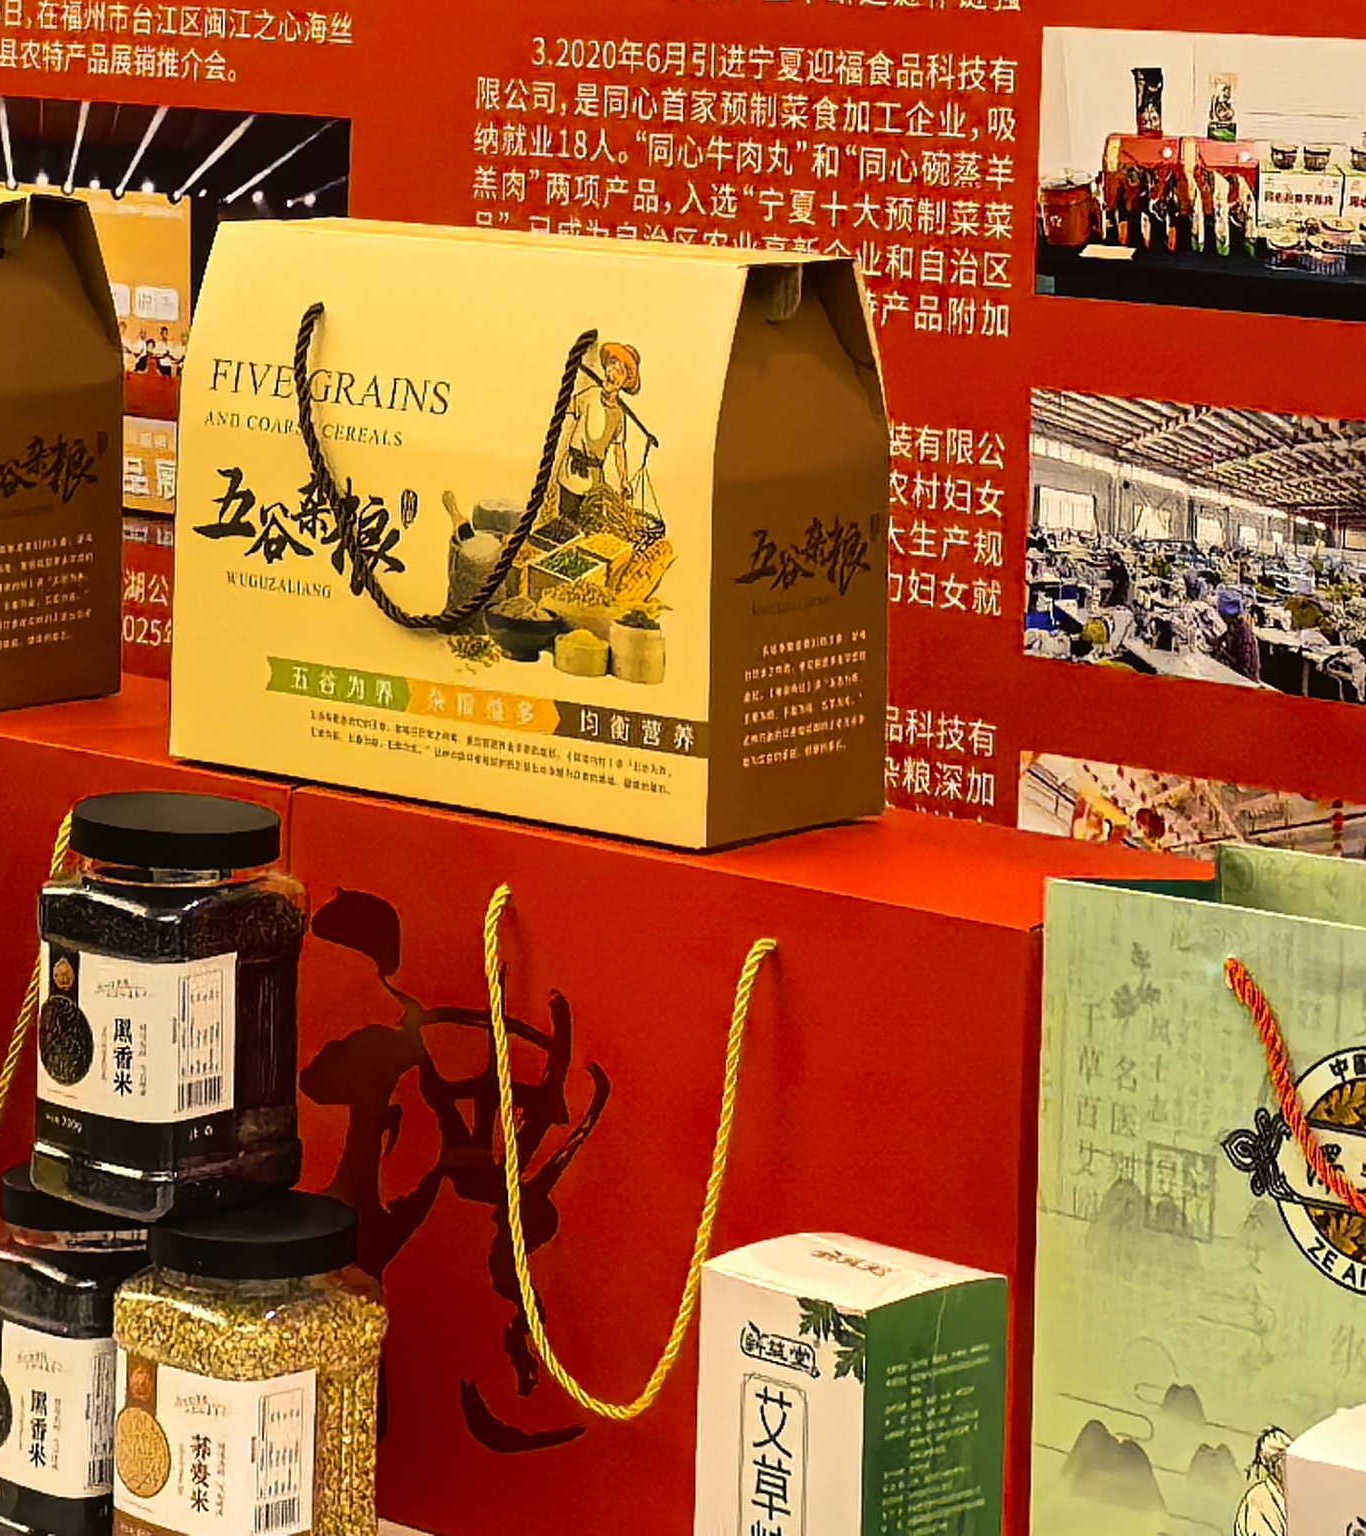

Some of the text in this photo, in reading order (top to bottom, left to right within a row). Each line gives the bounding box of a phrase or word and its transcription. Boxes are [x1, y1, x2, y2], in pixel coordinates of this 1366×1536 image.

[531, 36, 1017, 95] 3.2020年6月引进宁夏迎福食品科技有
[209, 358, 451, 417] FIVE GRAINS
[204, 412, 240, 430] AND
[321, 425, 403, 448] CEREALS
[192, 467, 407, 597] 五谷杂粮
[580, 708, 695, 750] 均衡营养
[113, 1017, 134, 1097] 黑香米
[1306, 1235, 1341, 1274] ZE
